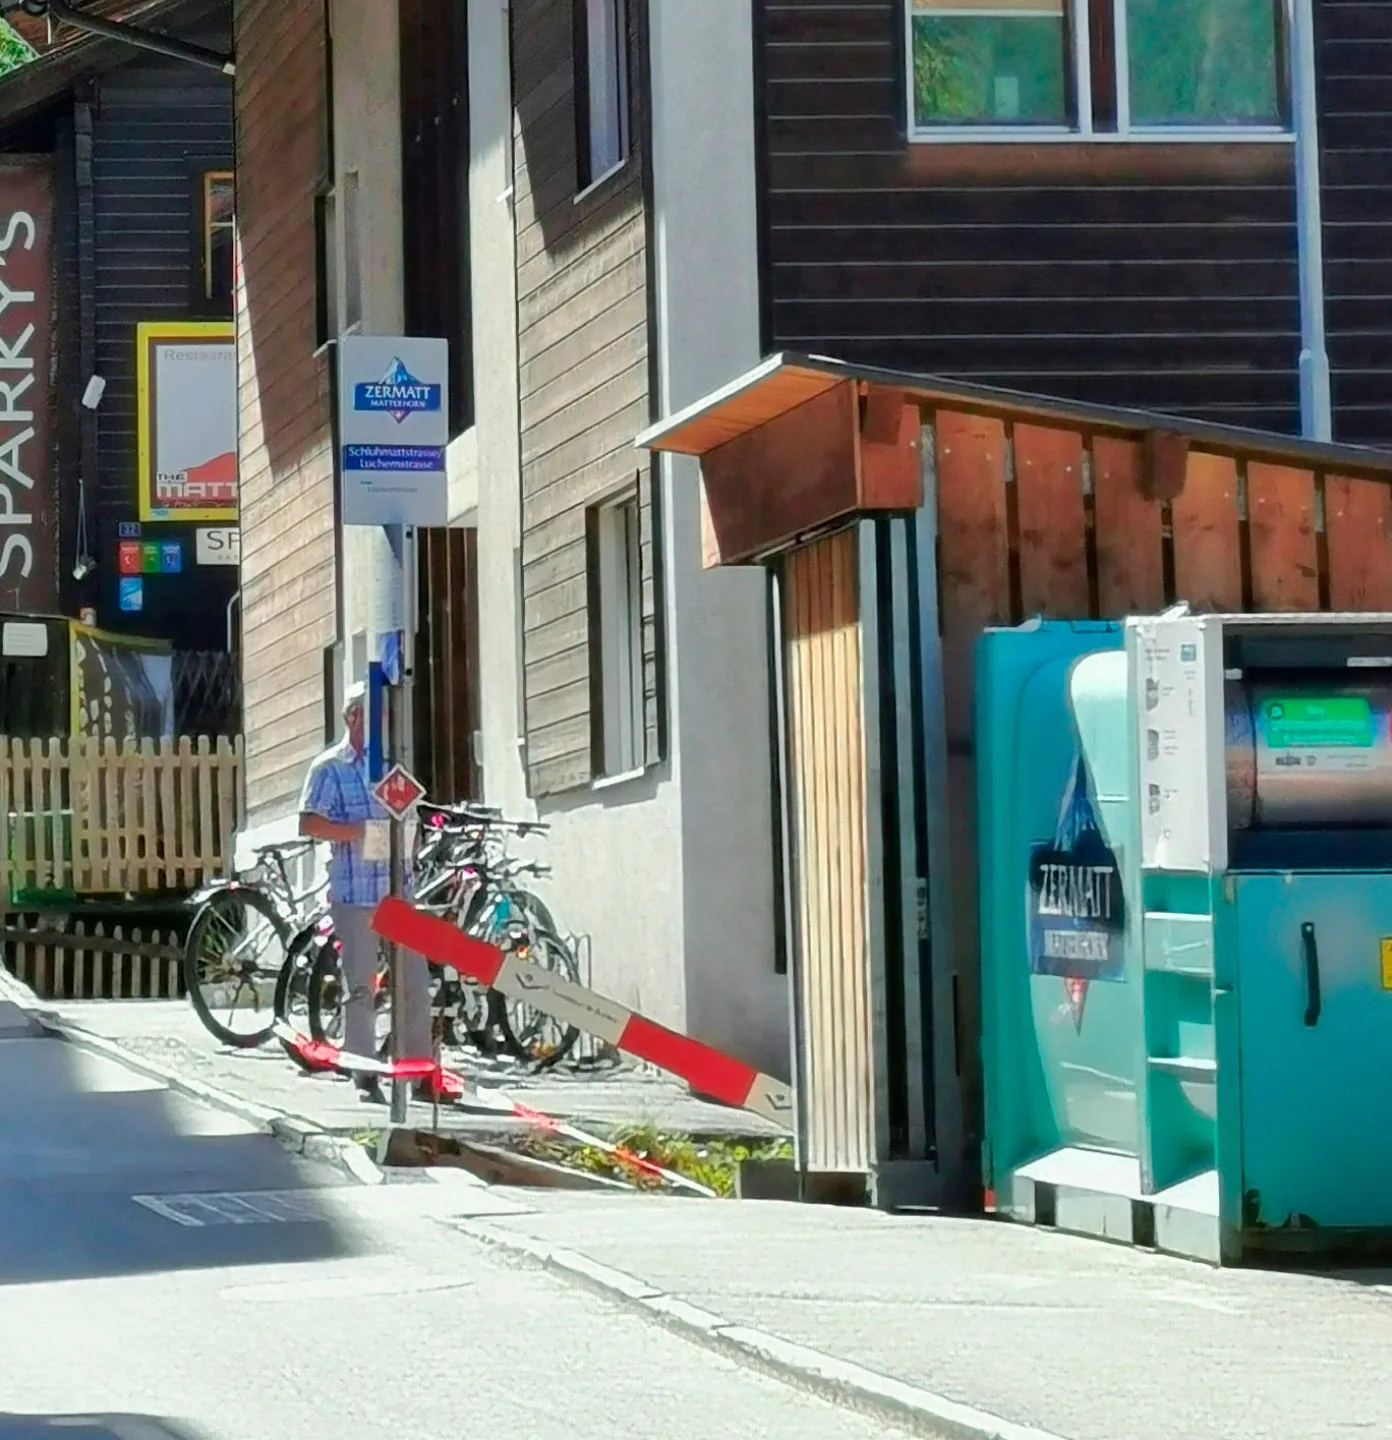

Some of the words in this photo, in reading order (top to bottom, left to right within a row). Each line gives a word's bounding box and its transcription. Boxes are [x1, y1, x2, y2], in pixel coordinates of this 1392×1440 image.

[364, 385, 432, 400] ZERMATT
[370, 399, 427, 409] MATTERHORN
[157, 473, 185, 482] THE
[1038, 863, 1114, 919] ZERMATT
